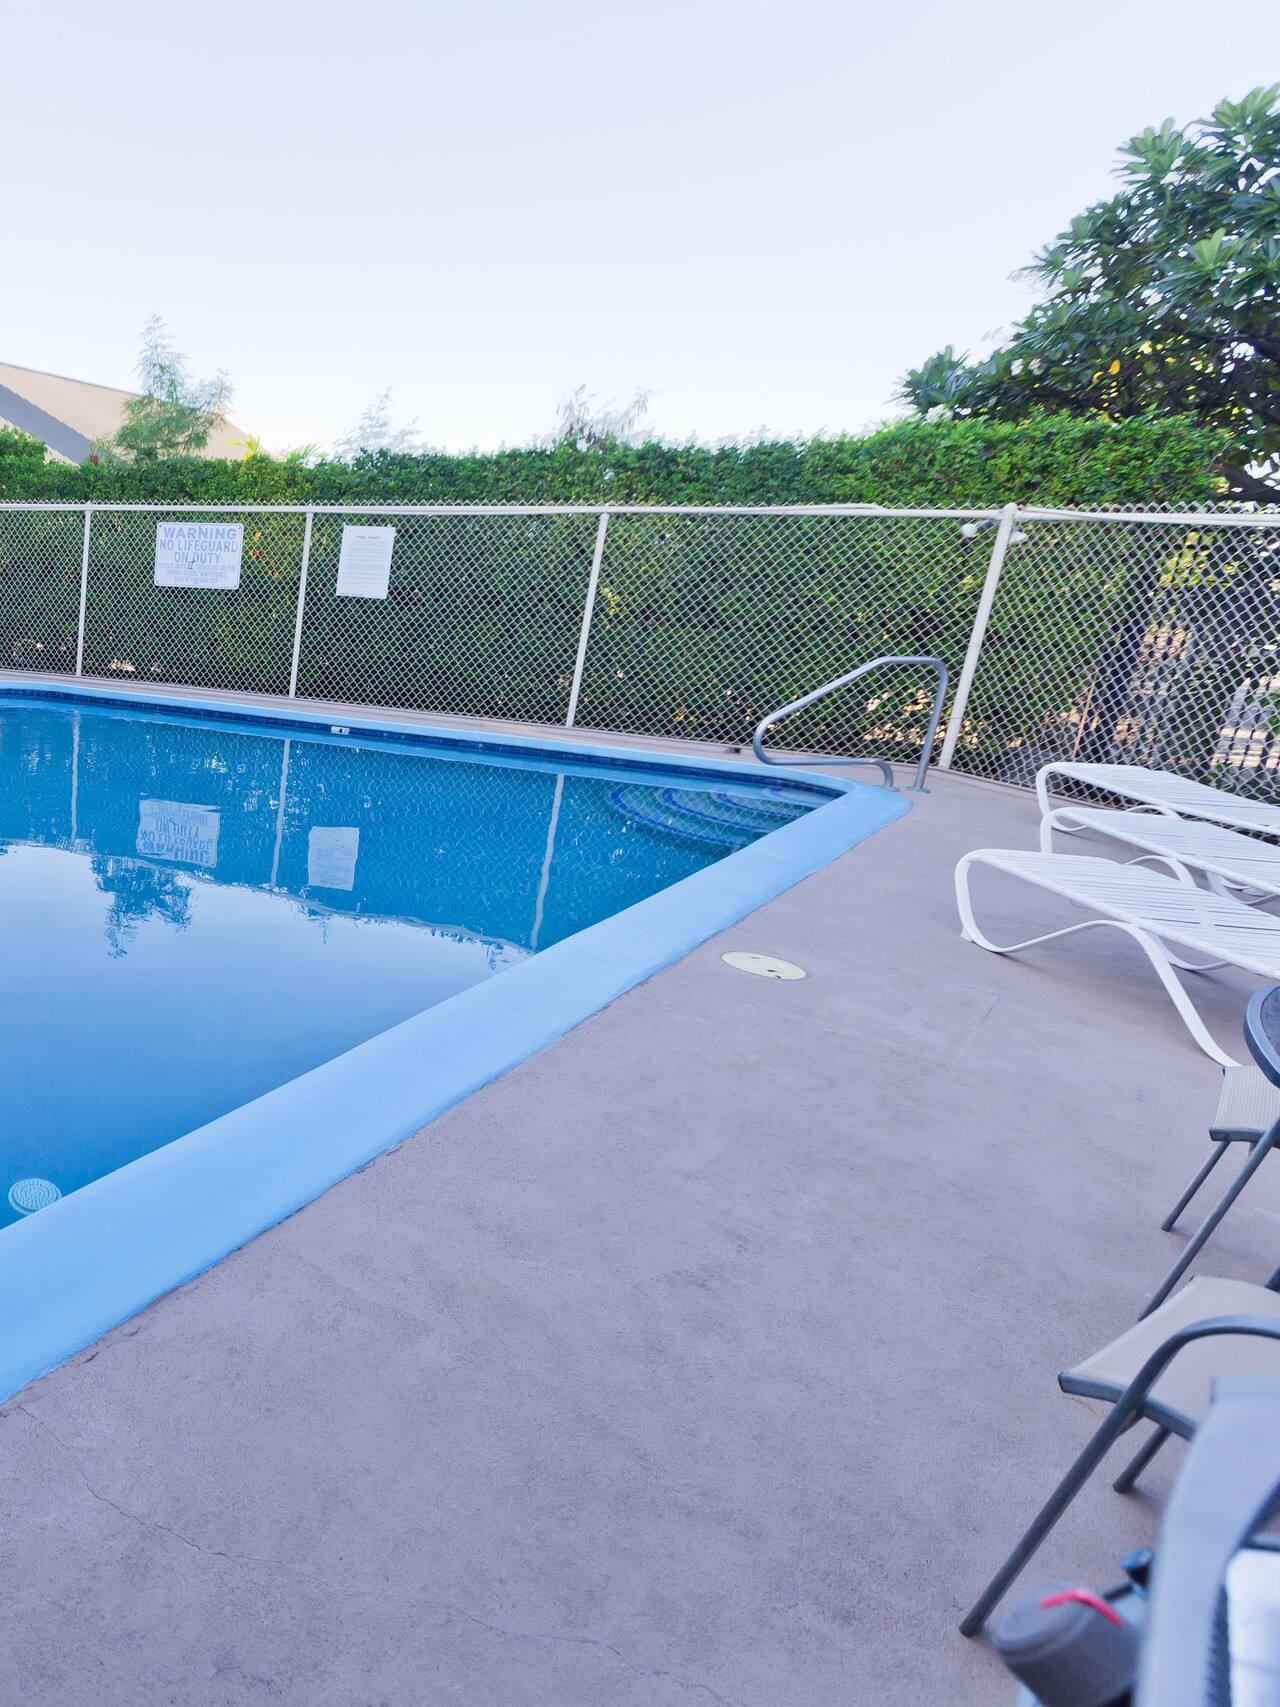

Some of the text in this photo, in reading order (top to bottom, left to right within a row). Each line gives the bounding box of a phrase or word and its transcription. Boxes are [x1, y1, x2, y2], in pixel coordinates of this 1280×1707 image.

[164, 527, 237, 539] WARNING
[160, 539, 237, 552] NO LIFEGUARD
[174, 552, 221, 563] ON DUTY
